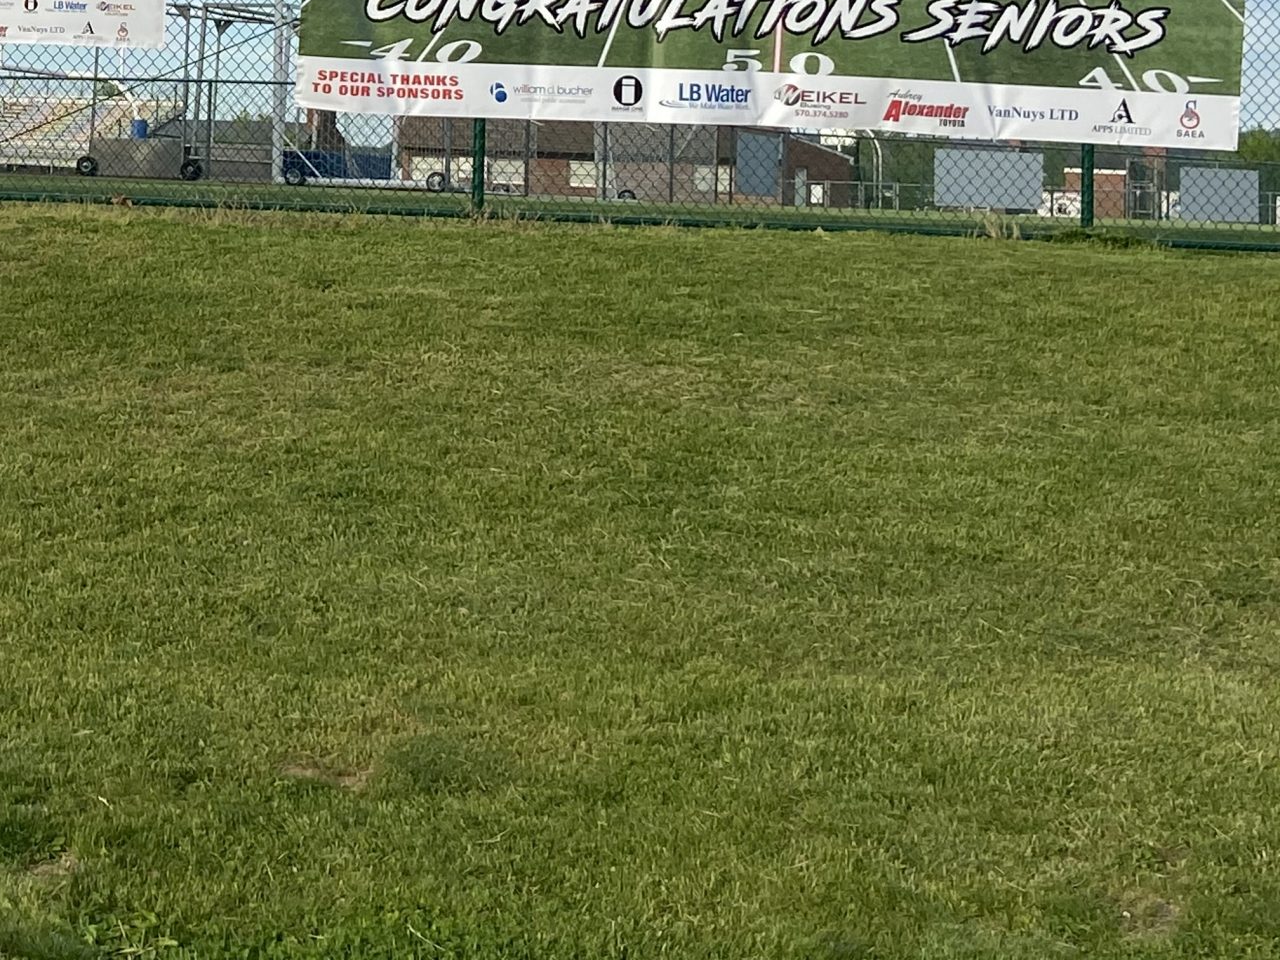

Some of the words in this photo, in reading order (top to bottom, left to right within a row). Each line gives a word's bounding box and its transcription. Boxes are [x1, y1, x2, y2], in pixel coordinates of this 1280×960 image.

[65, 1, 88, 10] Water
[317, 70, 384, 84] SPECIAL
[390, 74, 459, 86] THANKS
[312, 82, 331, 94] TO
[339, 85, 370, 96] OUR
[376, 87, 464, 100] SPONSORS
[557, 85, 593, 95] bucher
[679, 83, 701, 101] LB
[705, 84, 751, 103] Water
[883, 99, 969, 122] Alexander
[987, 105, 1045, 121] VanNuys
[1049, 108, 1079, 121] LTD
[939, 118, 965, 127] TOYOTA
[1091, 125, 1113, 134] APPS
[1114, 126, 1152, 136] LIMITED
[1176, 128, 1205, 139] SAEA
